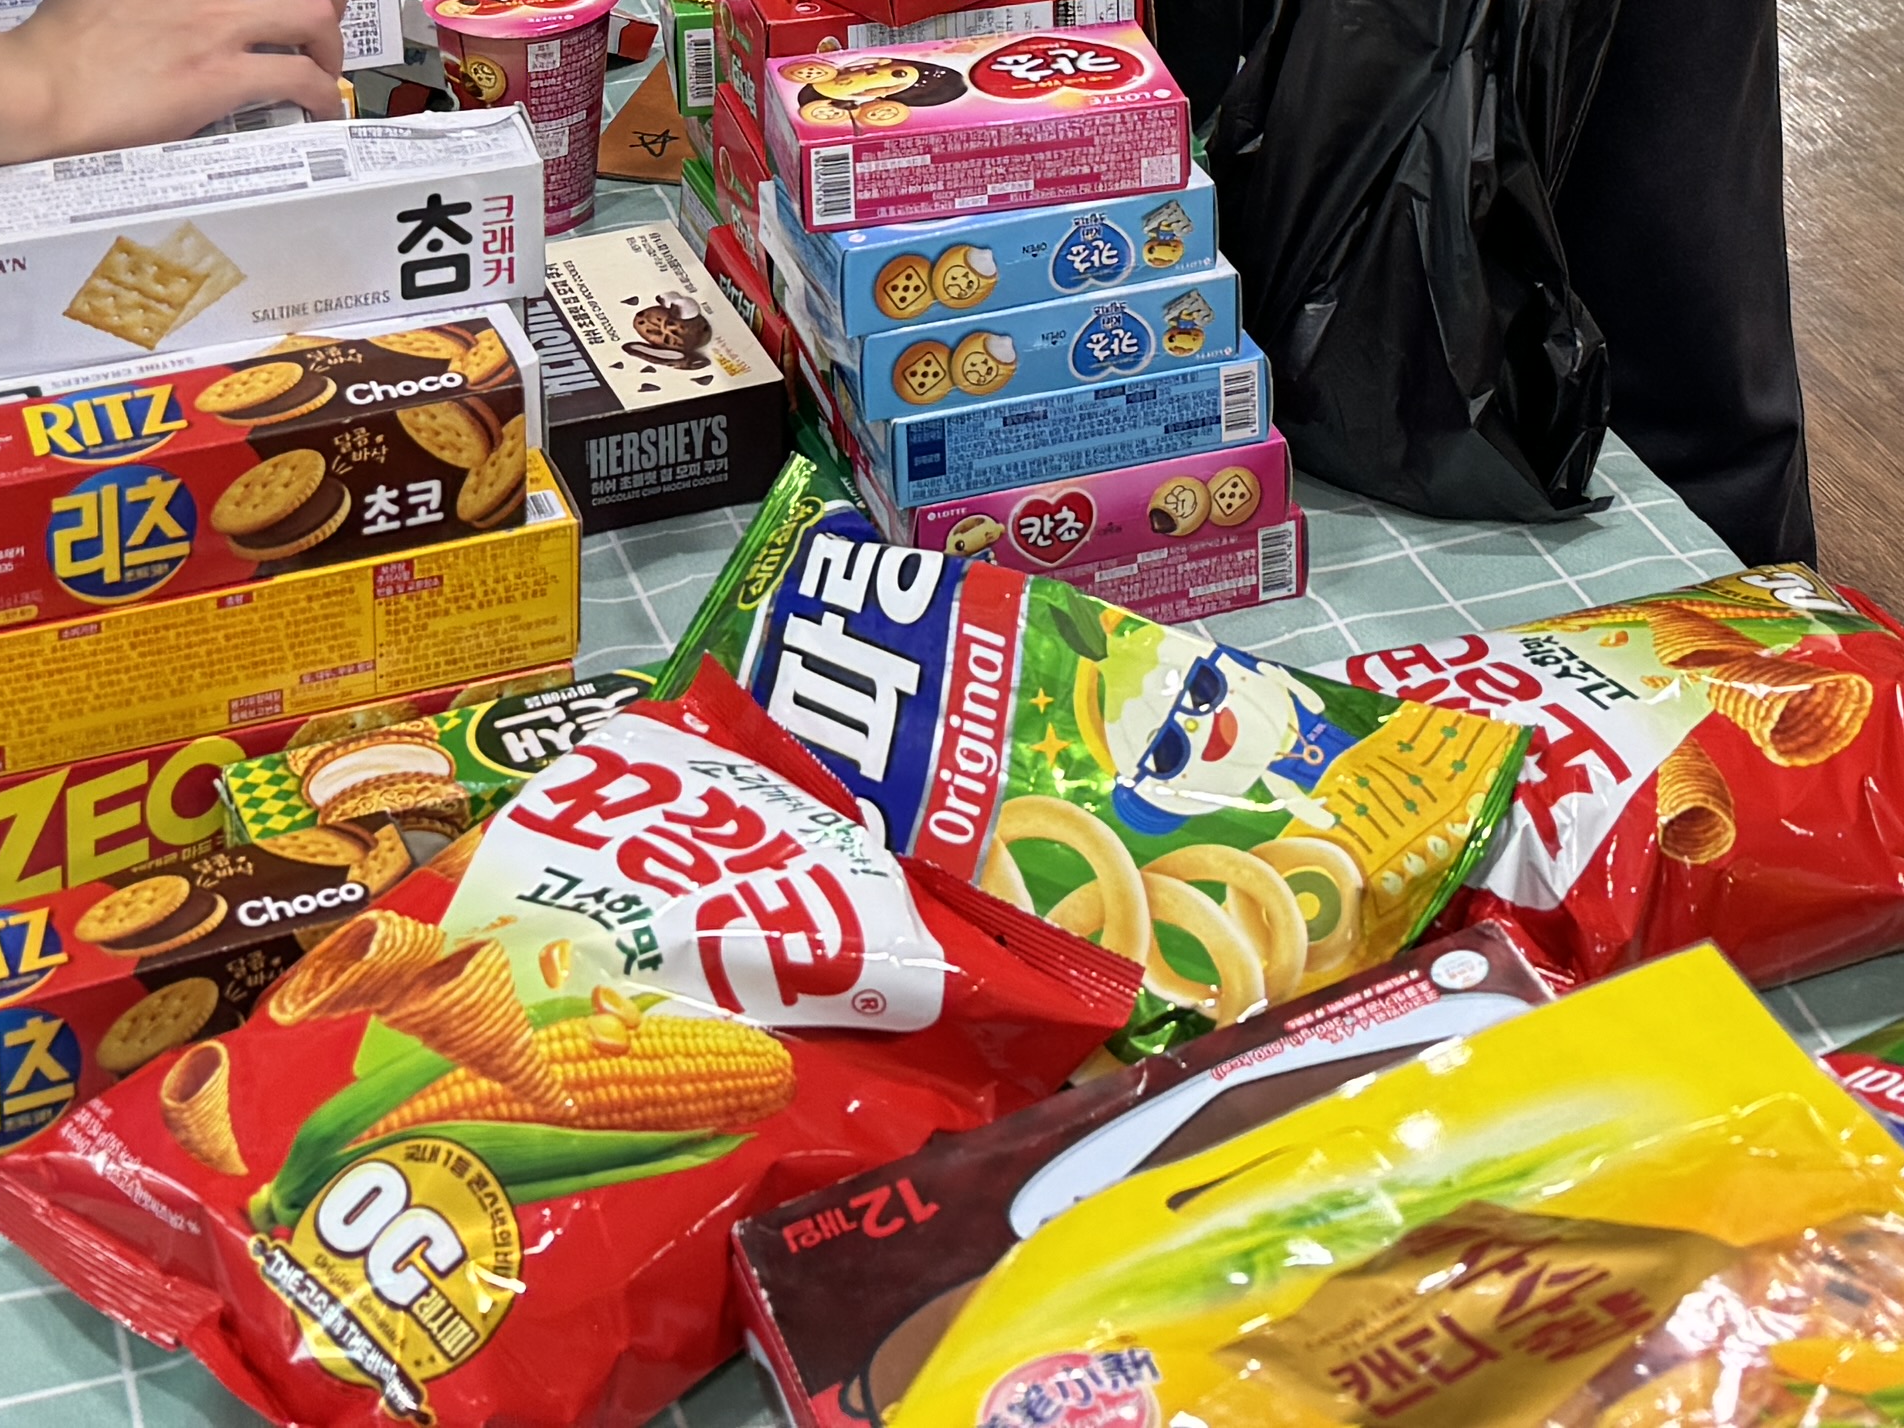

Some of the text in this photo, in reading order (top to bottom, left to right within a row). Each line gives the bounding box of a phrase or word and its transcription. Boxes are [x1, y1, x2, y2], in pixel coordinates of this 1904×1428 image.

[990, 44, 1123, 84] 칸쵸
[481, 193, 516, 288] 크래커
[1066, 240, 1120, 273] 칸쵸
[251, 288, 392, 324] SALTINE CRACKERS
[1086, 329, 1141, 362] 칸쵸
[22, 383, 189, 457] RITZ
[345, 372, 464, 405] Choco
[588, 414, 729, 480] HERSHEY'S
[50, 475, 192, 585] 리츠
[361, 479, 445, 536] 초코
[936, 505, 968, 521] LOTTE
[1018, 505, 1085, 546] 칸쵸
[767, 532, 945, 847] 파링
[927, 622, 1008, 846] Original
[235, 880, 366, 931] Choco
[507, 744, 868, 1015] 꼬깔콘
[516, 864, 667, 978] 고소한맛
[314, 1159, 467, 1312] OC
[781, 1175, 942, 1258] 12개입
[414, 1288, 480, 1364] 레시피
